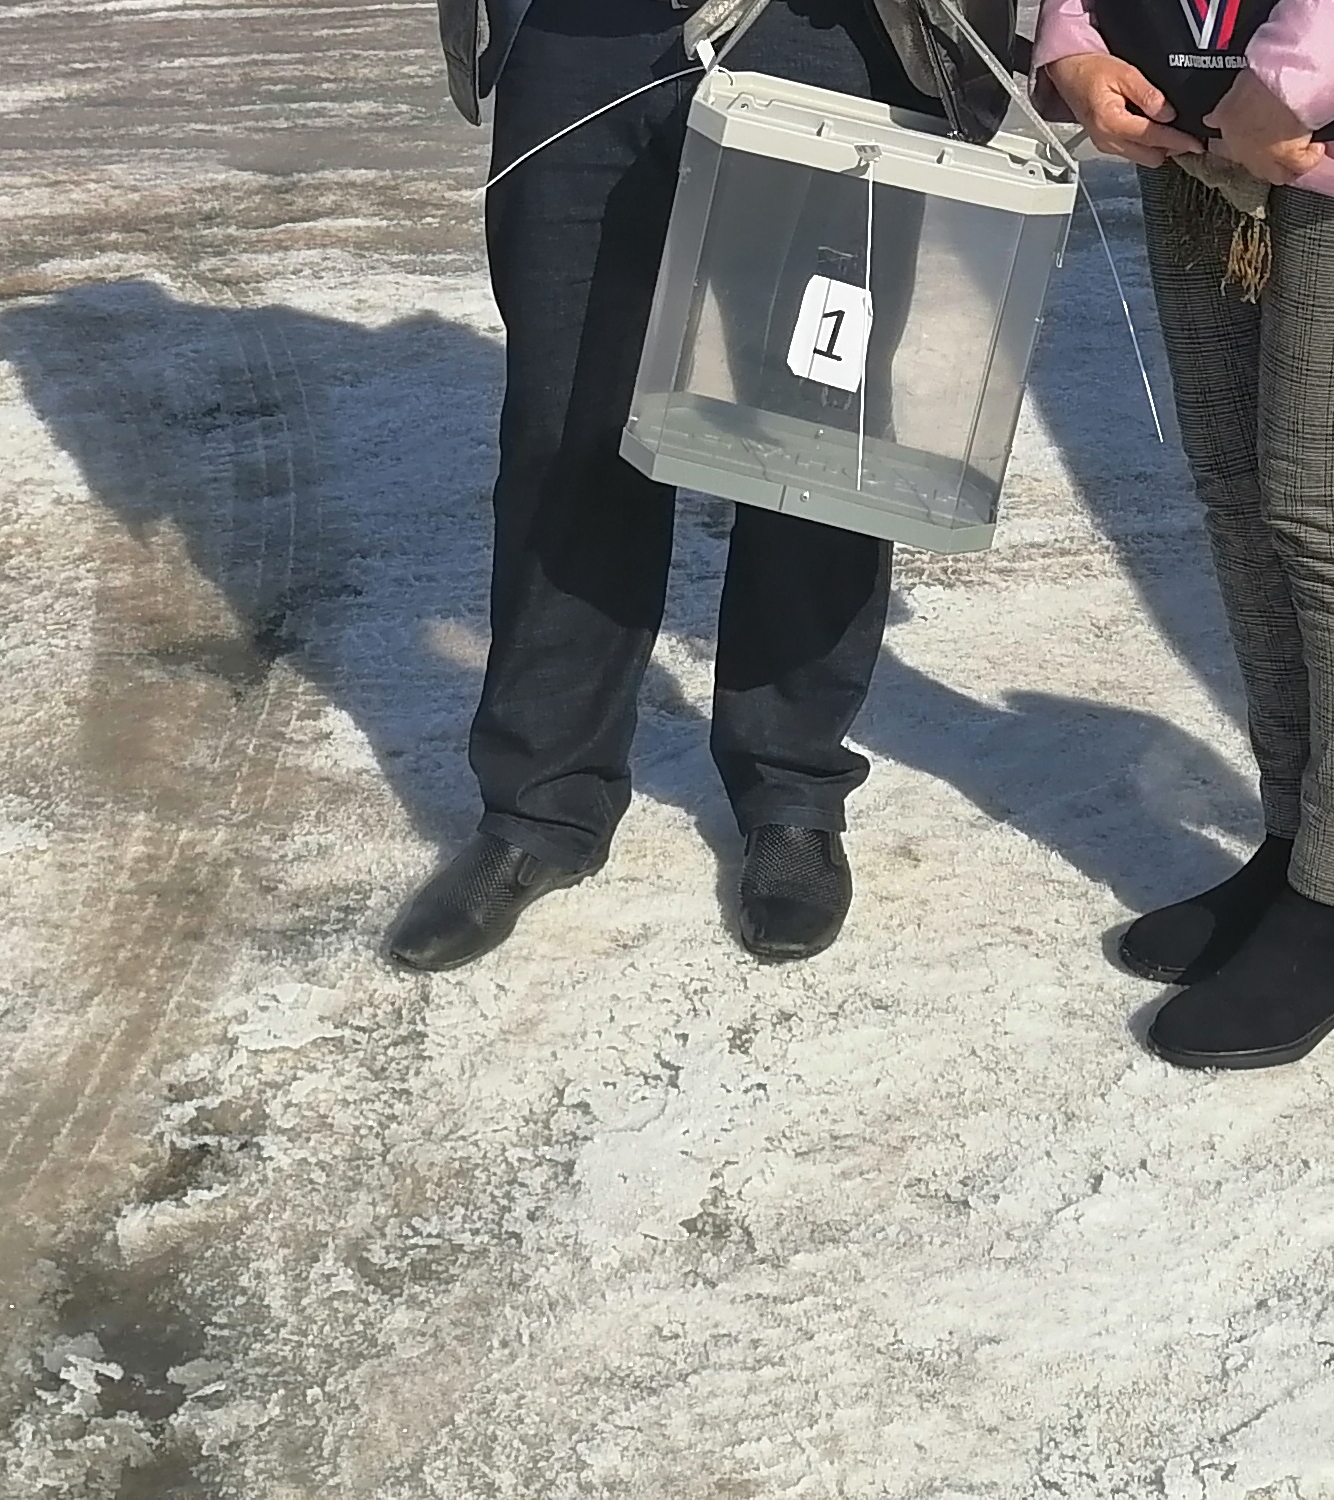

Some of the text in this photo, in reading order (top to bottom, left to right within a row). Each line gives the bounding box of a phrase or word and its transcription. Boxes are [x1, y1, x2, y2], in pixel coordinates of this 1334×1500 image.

[1169, 54, 1248, 69] САРАТОВСКАЯ ОБЛА
[812, 309, 846, 362] 1
